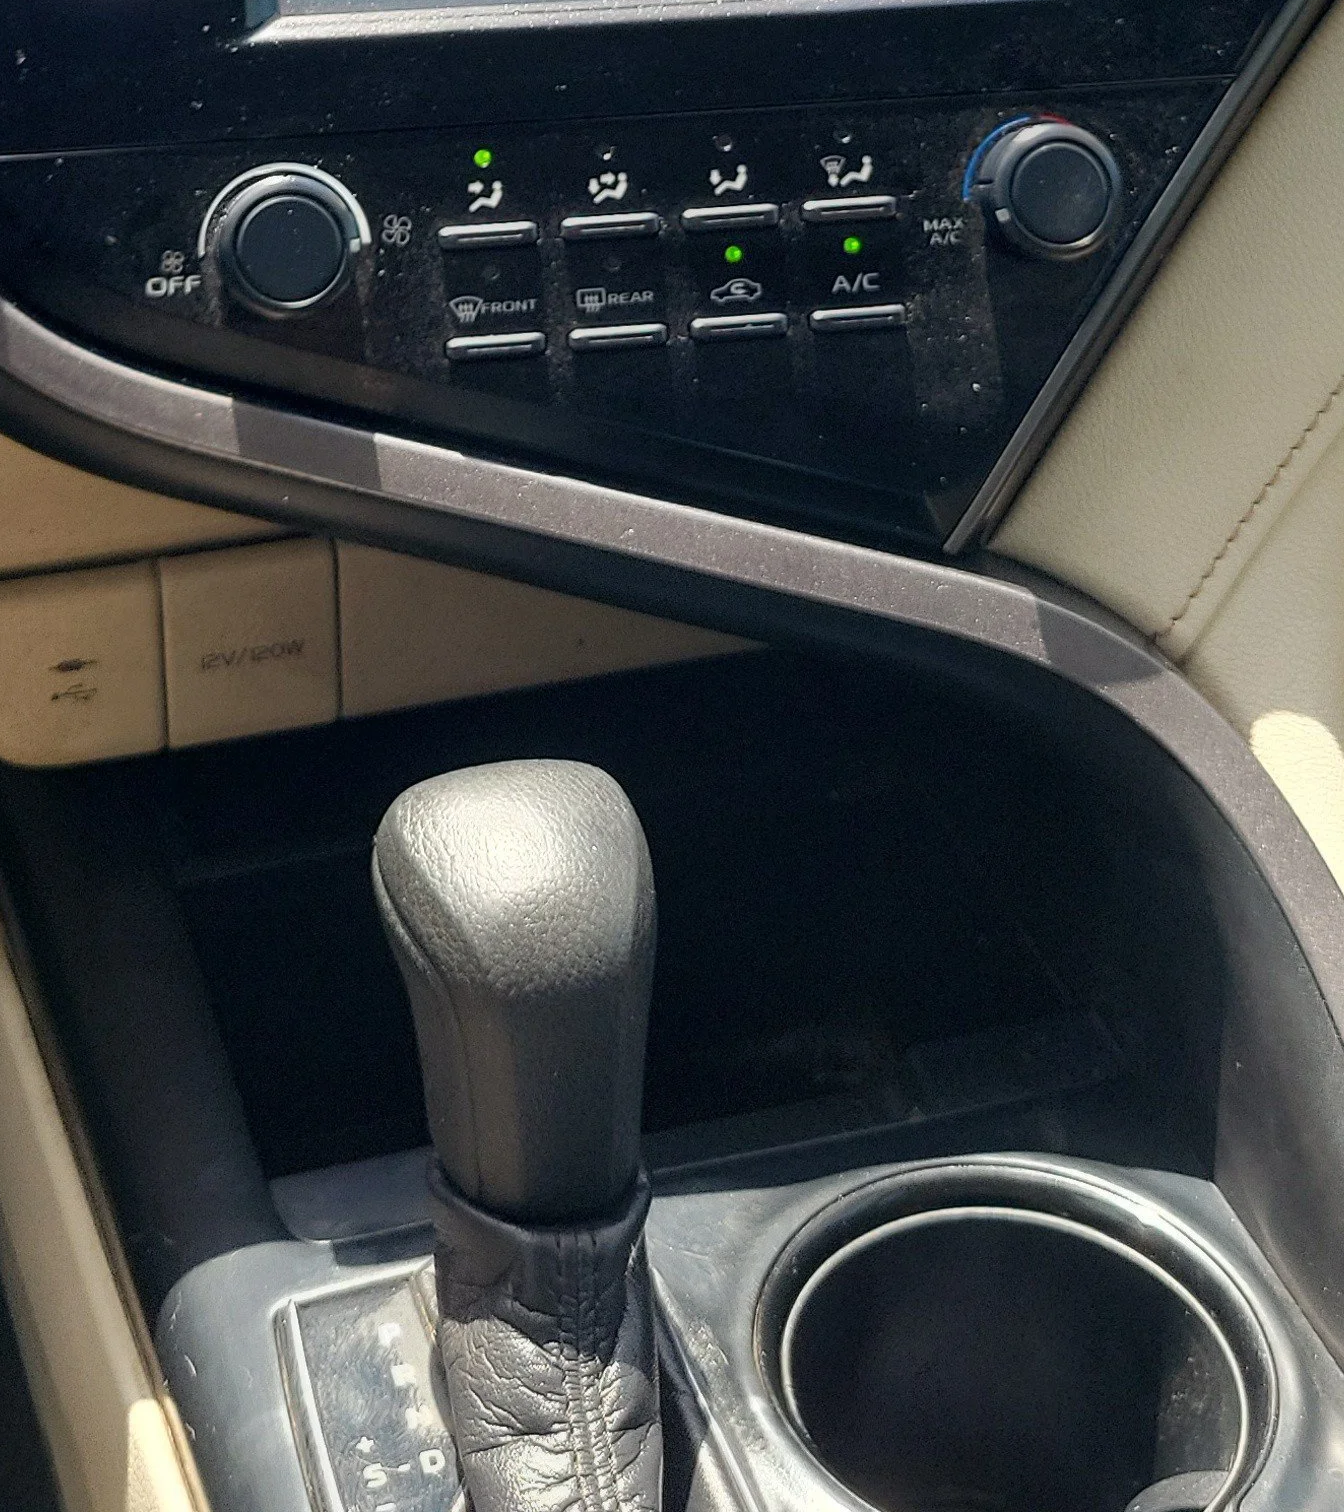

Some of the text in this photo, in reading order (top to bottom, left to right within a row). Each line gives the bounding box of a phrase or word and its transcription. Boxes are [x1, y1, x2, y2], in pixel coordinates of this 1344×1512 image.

[923, 216, 967, 232] MAX
[929, 231, 961, 246] A/C
[145, 274, 202, 298] OFF
[832, 272, 881, 294] A/C
[479, 297, 537, 314] FRONT
[607, 289, 655, 306] REAR
[419, 1448, 446, 1475] D
[362, 1462, 388, 1489] S
